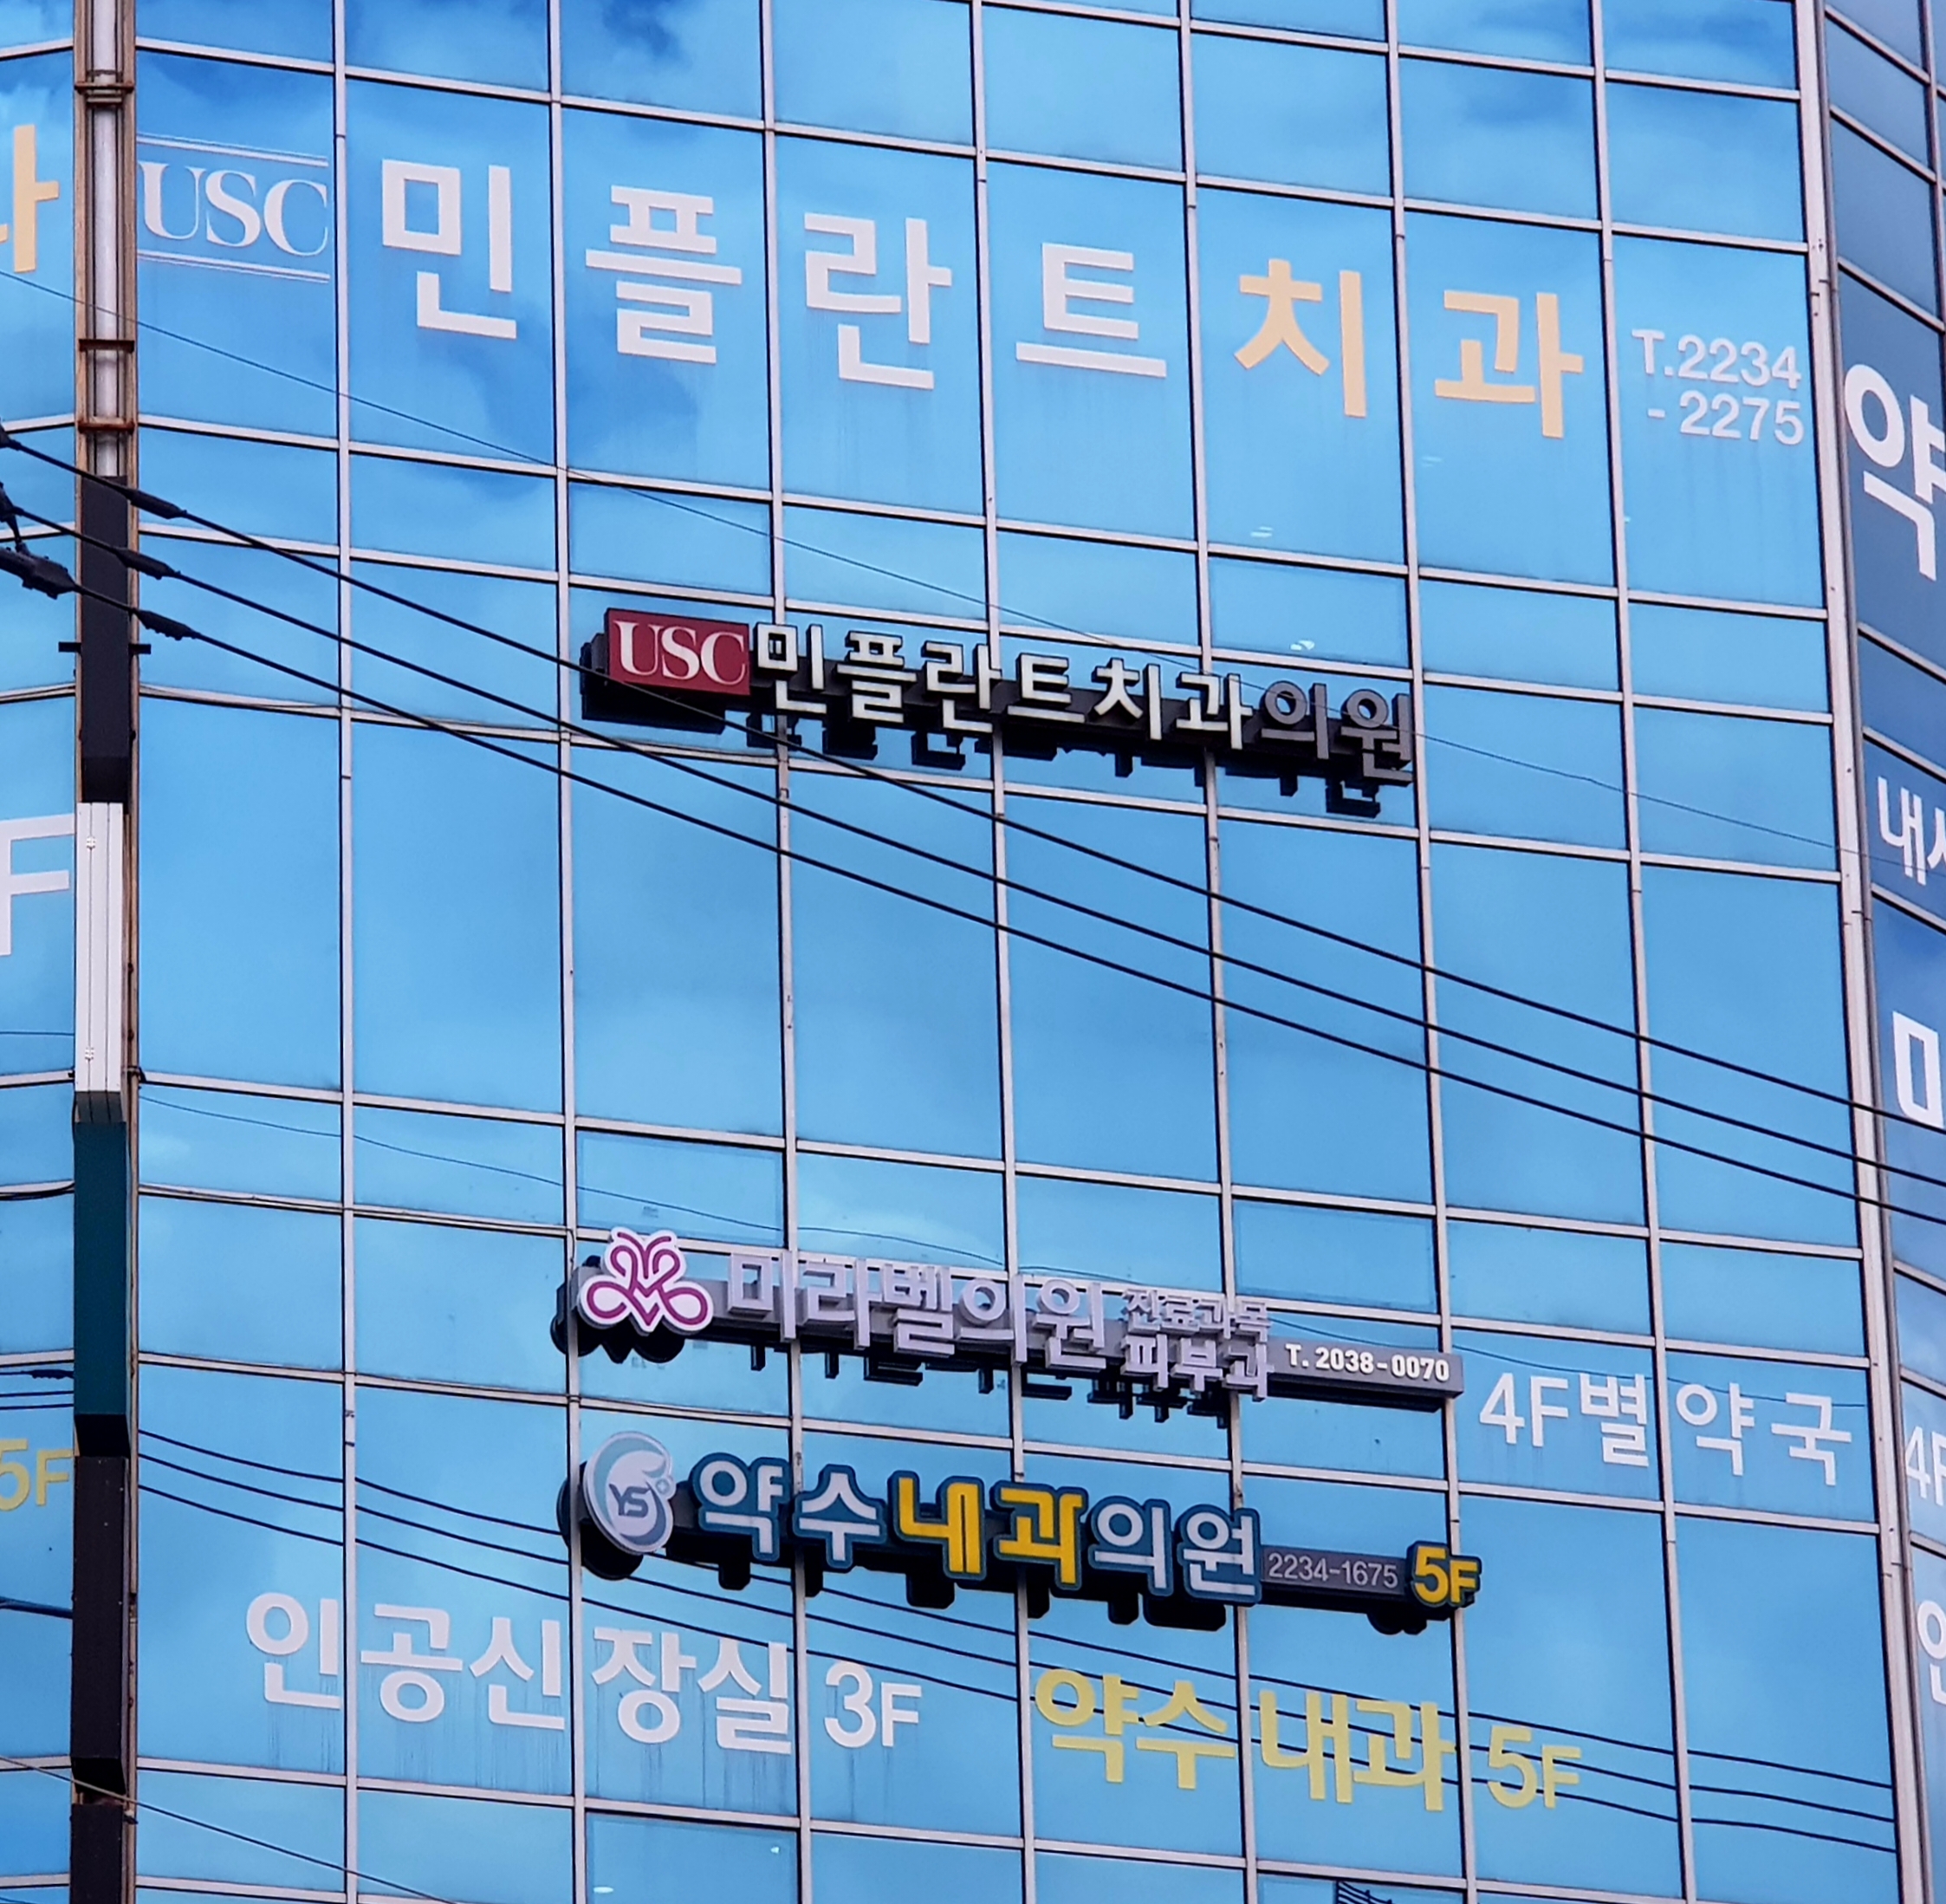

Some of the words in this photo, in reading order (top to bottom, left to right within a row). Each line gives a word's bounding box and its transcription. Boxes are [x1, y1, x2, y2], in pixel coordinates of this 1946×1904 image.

[138, 160, 329, 257] USC
[613, 619, 748, 687] USC
[756, 621, 1414, 783] 민플란트치과의원
[727, 1251, 1106, 1374] 미라벨의원
[1122, 1288, 1272, 1342] 진료과목
[1121, 1333, 1275, 1400] 피부과
[1315, 1347, 1450, 1382] 2038-0070
[695, 1456, 1259, 1599] 약수내과의원
[1267, 1550, 1399, 1590] 2234-1675
[1412, 1544, 1480, 1607] 5F
[245, 1591, 793, 1756] 인공신장실
[823, 1660, 924, 1749] 3F
[1486, 1725, 1583, 1810] 5F
